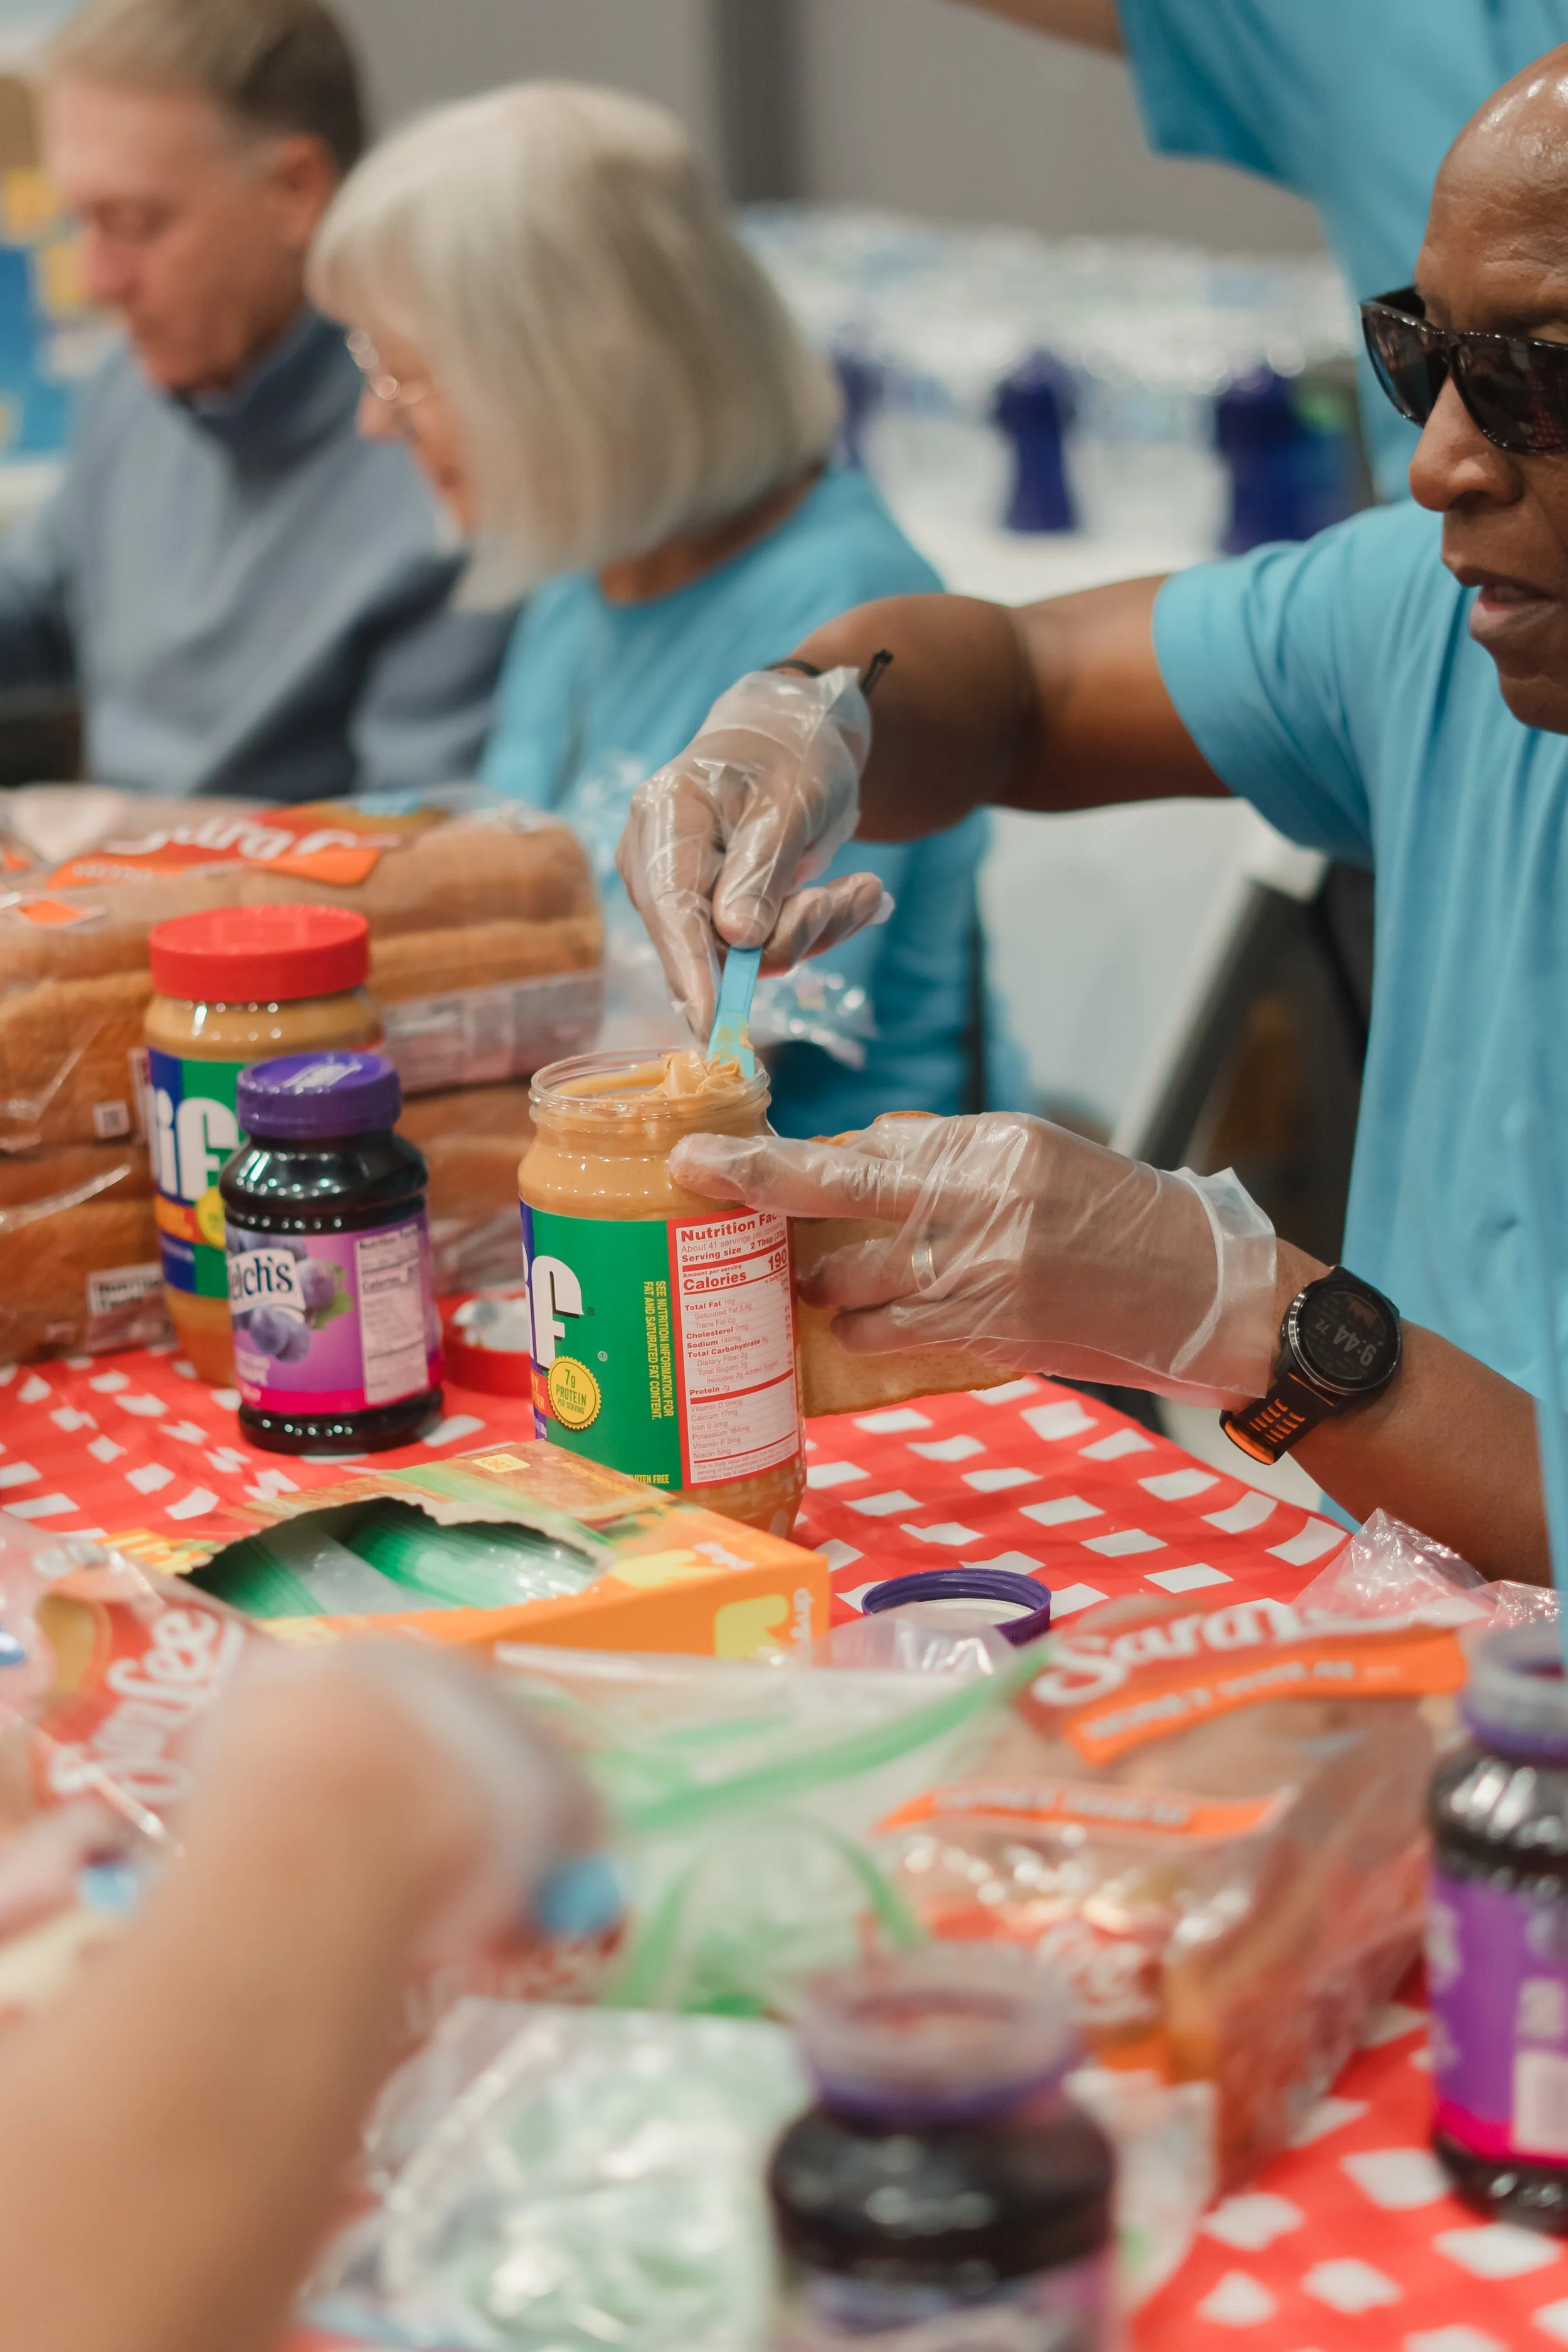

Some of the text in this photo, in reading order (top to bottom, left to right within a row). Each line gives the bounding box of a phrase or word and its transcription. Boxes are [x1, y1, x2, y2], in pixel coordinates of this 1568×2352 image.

[681, 1213, 781, 1242] Nutrition Fac
[682, 1244, 706, 1253] About
[721, 1235, 751, 1247] servings
[682, 1251, 720, 1262] Serving
[724, 1248, 741, 1256] size
[757, 1236, 773, 1247] Tbsp
[684, 1248, 786, 1290] Calories 190
[229, 1256, 293, 1301] elch's
[694, 1308, 726, 1320] Saturated
[686, 1323, 748, 1339] Cholesterol 0mg
[696, 1320, 714, 1329] Trans
[656, 1281, 674, 1417] SEE NUTRITION INFORMATION FOR
[687, 1335, 741, 1348] Sodium 140mg
[688, 1350, 708, 1358] Total
[711, 1338, 760, 1355] Carbohydrate
[1333, 1324, 1377, 1367] 9:44
[644, 1281, 662, 1420] FAT AND SATURATED FAT CONTENT.
[697, 1357, 721, 1367] Dietary
[716, 1365, 738, 1374] Sugars
[564, 1369, 576, 1388] 7g
[707, 1374, 733, 1384] Includes
[744, 1367, 761, 1376] Added
[556, 1384, 586, 1407] PROTEIN
[690, 1387, 719, 1395] Protein
[566, 1402, 584, 1414] SERVING
[692, 1431, 727, 1440] Potassium
[693, 1441, 718, 1449] Vitamin
[694, 1451, 714, 1459] Niacin
[653, 1474, 670, 1484] FREE
